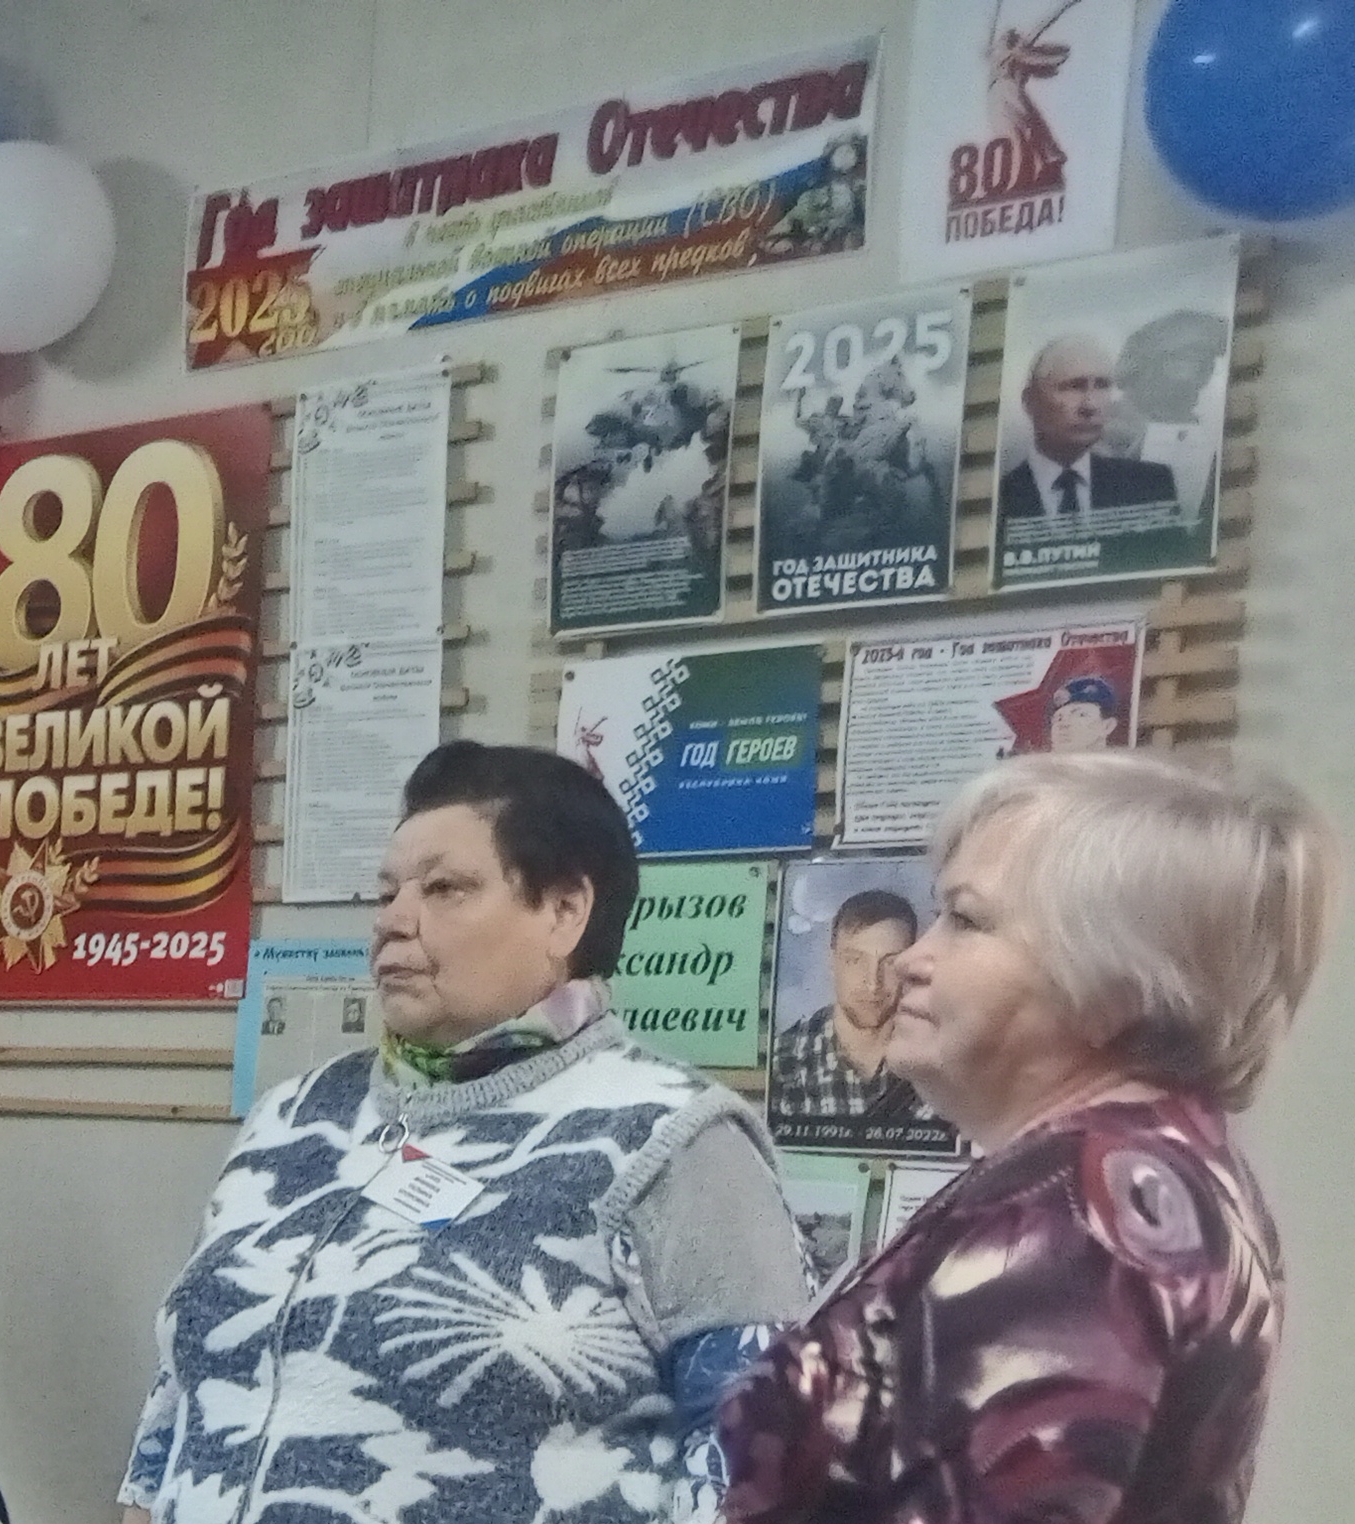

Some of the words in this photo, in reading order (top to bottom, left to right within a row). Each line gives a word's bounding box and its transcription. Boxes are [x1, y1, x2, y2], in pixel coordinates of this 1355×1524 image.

[587, 62, 868, 175] Отечества
[949, 136, 1015, 201] 80
[562, 216, 668, 253] операции
[683, 180, 776, 239] (СВО)
[945, 195, 1065, 244] ПОБЕДА!
[485, 264, 586, 306] подвигах
[594, 252, 641, 286] всех
[652, 227, 758, 281] предков,
[189, 270, 313, 344] 2025
[781, 309, 953, 391] 2025
[772, 558, 809, 576] ГОД
[812, 544, 938, 573] ЗАЩИТНИКА
[771, 565, 936, 602] ОТЕЧЕСТВА
[32, 636, 119, 691] ЛЕТ
[951, 641, 975, 658] Год
[680, 740, 720, 769] ГОД
[725, 735, 798, 765] ГЕРОЕВ
[629, 893, 747, 931] рызов
[72, 931, 227, 968] 1945-2025
[616, 943, 734, 986] сандр
[622, 1006, 747, 1031] лаевич
